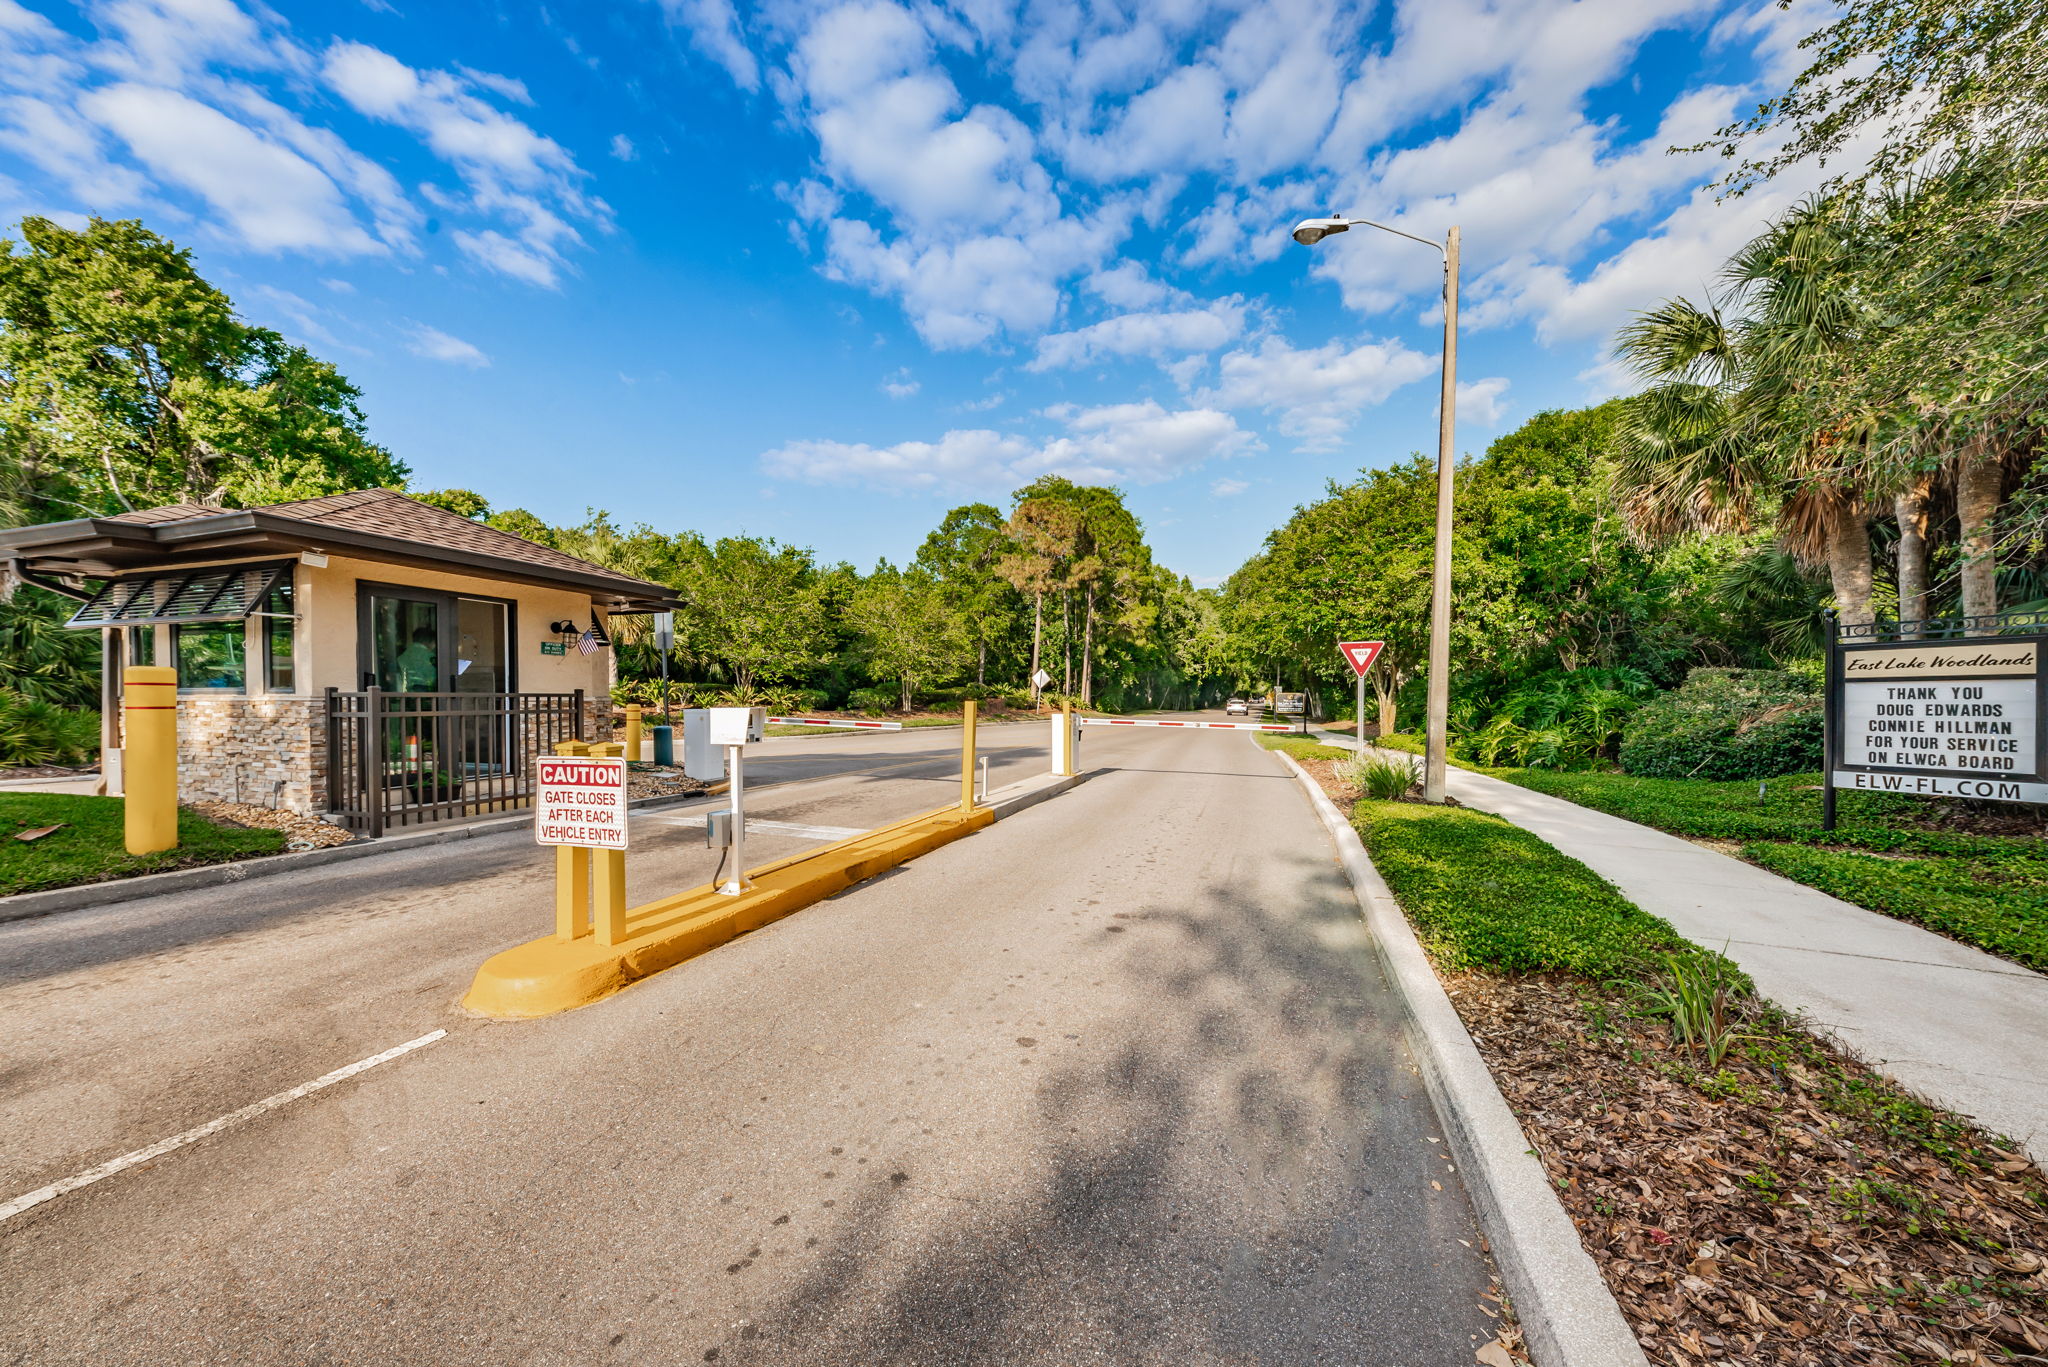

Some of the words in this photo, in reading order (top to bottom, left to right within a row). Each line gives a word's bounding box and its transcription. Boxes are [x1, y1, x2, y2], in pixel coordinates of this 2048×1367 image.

[1847, 658, 1884, 671] East
[1885, 656, 1926, 670] Lake
[1930, 652, 2034, 668] Woodlands
[1887, 687, 1937, 700] THANK
[1951, 687, 1983, 700] YOU
[1877, 704, 1914, 717] DOUG
[1925, 704, 2003, 717] EDWARDS
[1869, 720, 1925, 733] CONNIE
[1935, 721, 2012, 735] HILLMAN
[1866, 735, 1893, 748] FOR
[1900, 736, 1939, 750] YOUR
[1947, 737, 2018, 753] SERVICE
[1868, 751, 1888, 764] ON
[1896, 752, 1947, 767] ELWCA
[1958, 755, 2014, 770] BOARD
[542, 766, 620, 785] CAUTION
[1855, 774, 2021, 800] ELW-FL.COM
[545, 791, 574, 804] GATE
[576, 791, 616, 806] CLOSES
[548, 809, 583, 822] AFTER
[585, 810, 614, 823] EACH
[541, 825, 586, 840] VEHICLE
[588, 828, 621, 842] ENTRY
